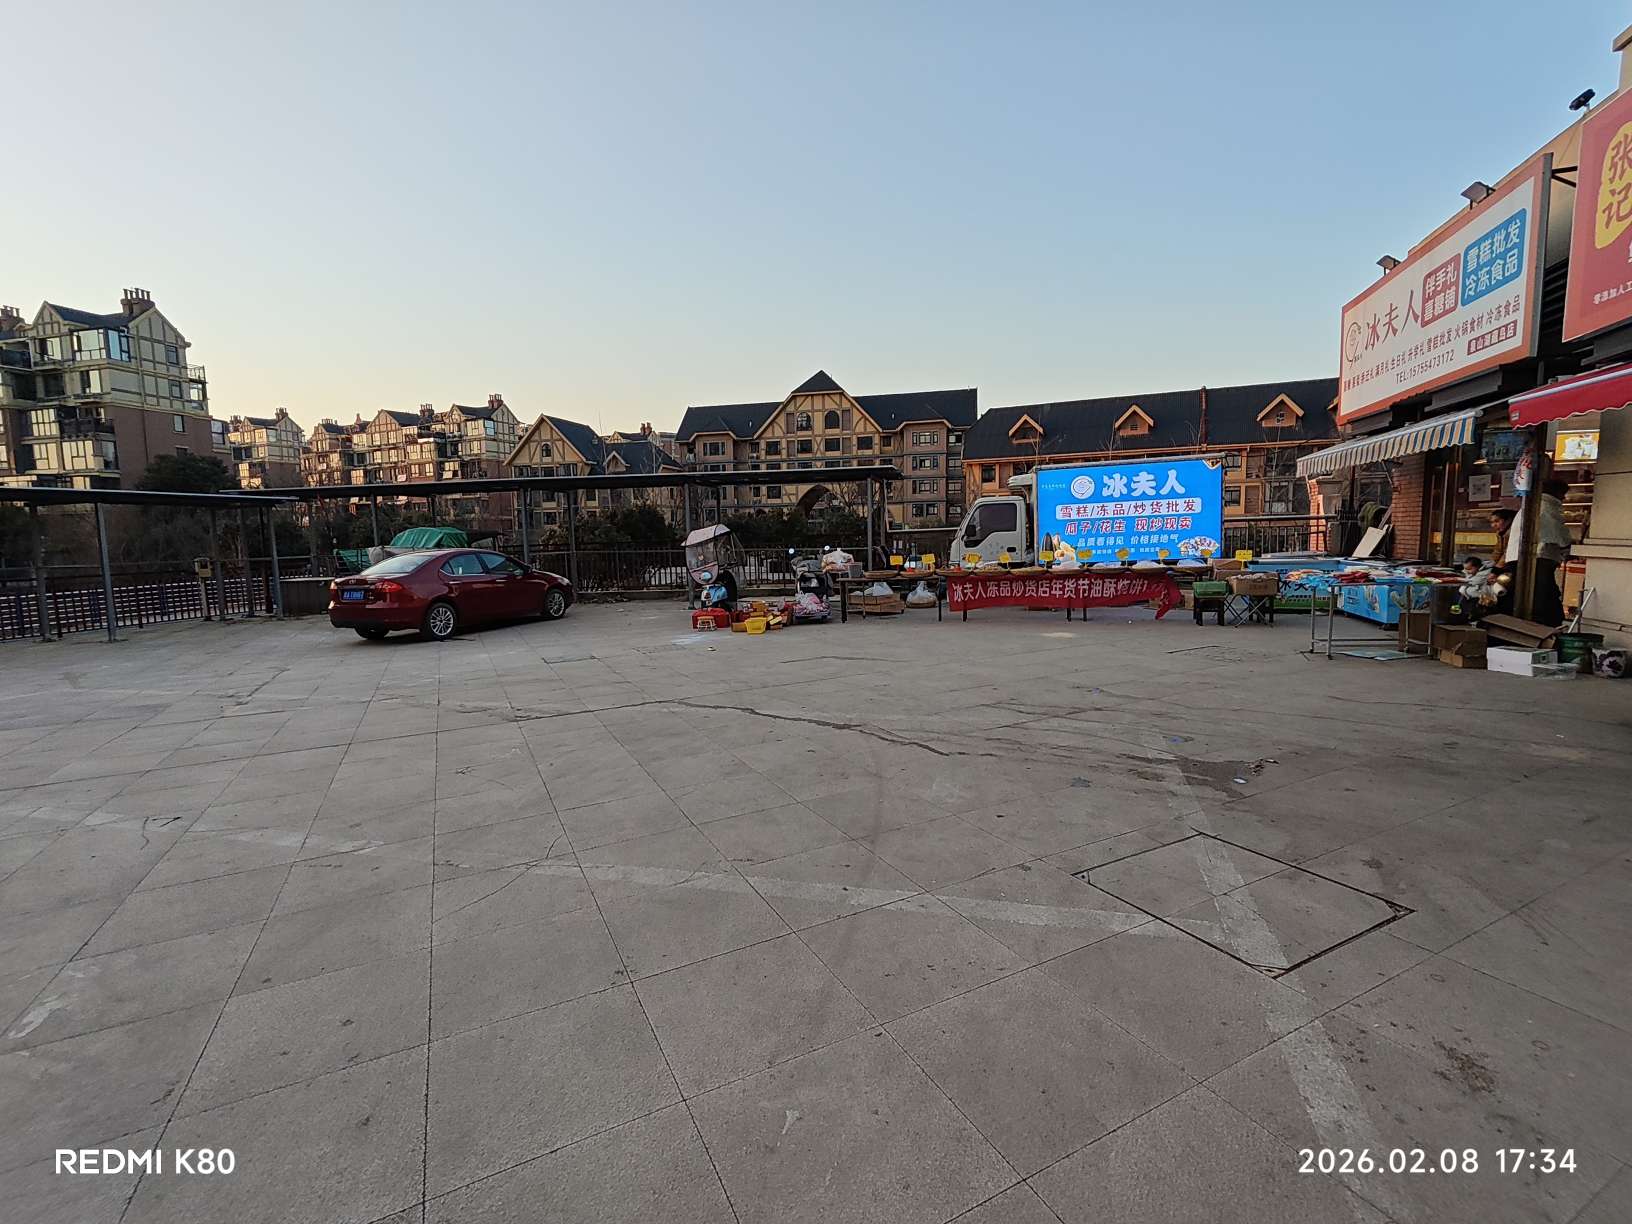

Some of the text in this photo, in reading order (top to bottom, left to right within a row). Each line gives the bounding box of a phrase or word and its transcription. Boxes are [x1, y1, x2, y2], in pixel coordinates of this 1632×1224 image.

[1467, 220, 1521, 273] 雪糕批发
[1426, 264, 1457, 299] 伴手礼
[1465, 252, 1518, 300] 冷冻食品
[1364, 290, 1420, 351] 冰夫人
[1486, 295, 1521, 325] 冷冻食品
[1102, 469, 1186, 498] 冰夫人
[1060, 499, 1196, 518] 雪糕/冻品/炒货批发
[1065, 519, 1126, 535] 瓜子/花生
